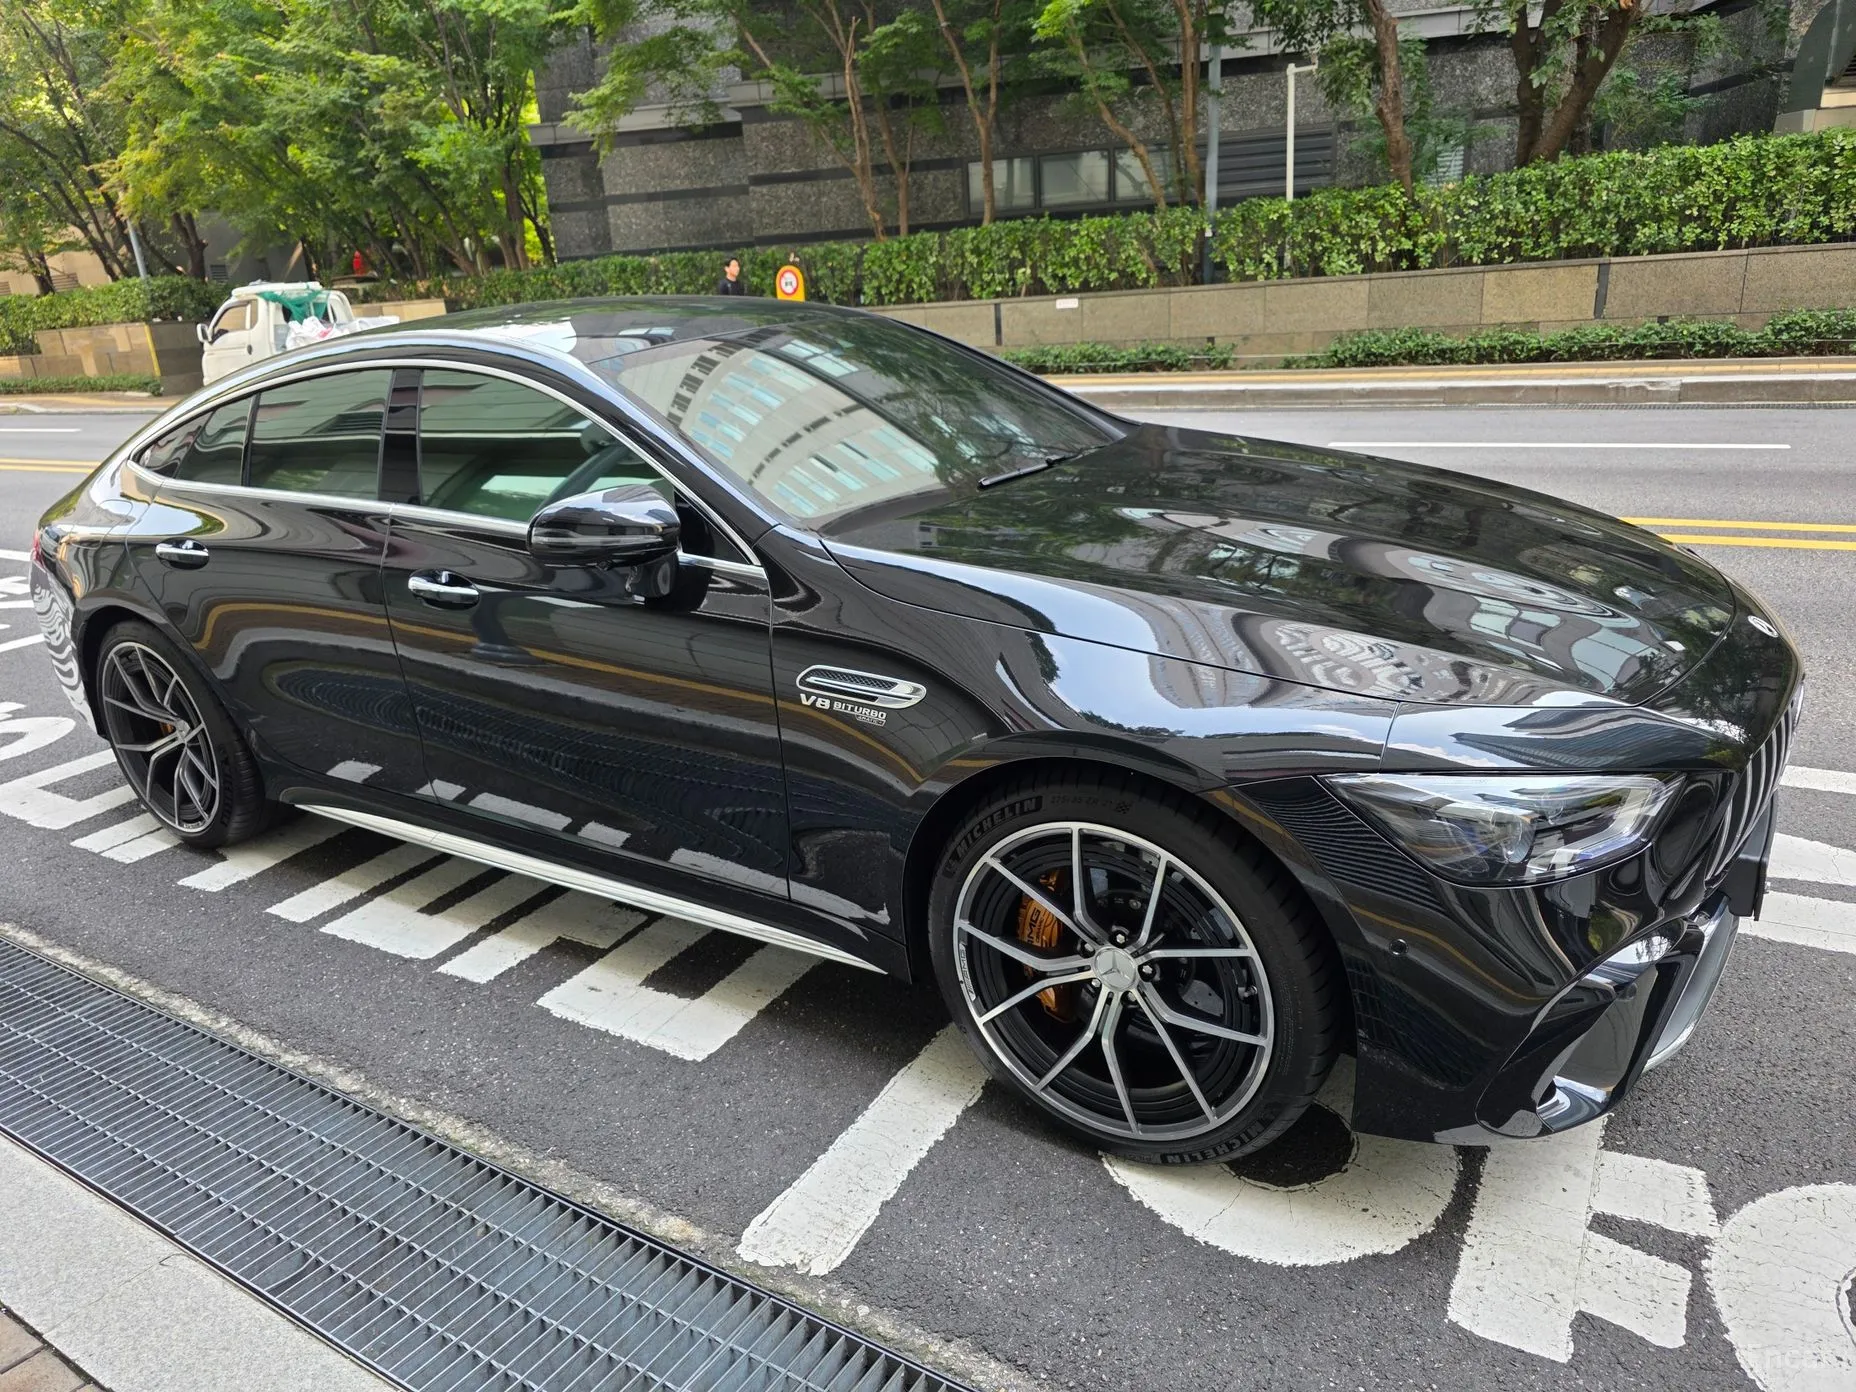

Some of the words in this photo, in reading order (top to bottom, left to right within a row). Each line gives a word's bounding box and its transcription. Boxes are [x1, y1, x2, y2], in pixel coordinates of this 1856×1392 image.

[800, 693, 830, 710] V8
[833, 701, 887, 719] BITURBO
[957, 799, 1037, 858] MICHELIN
[1166, 1118, 1266, 1164] MICHELIN
